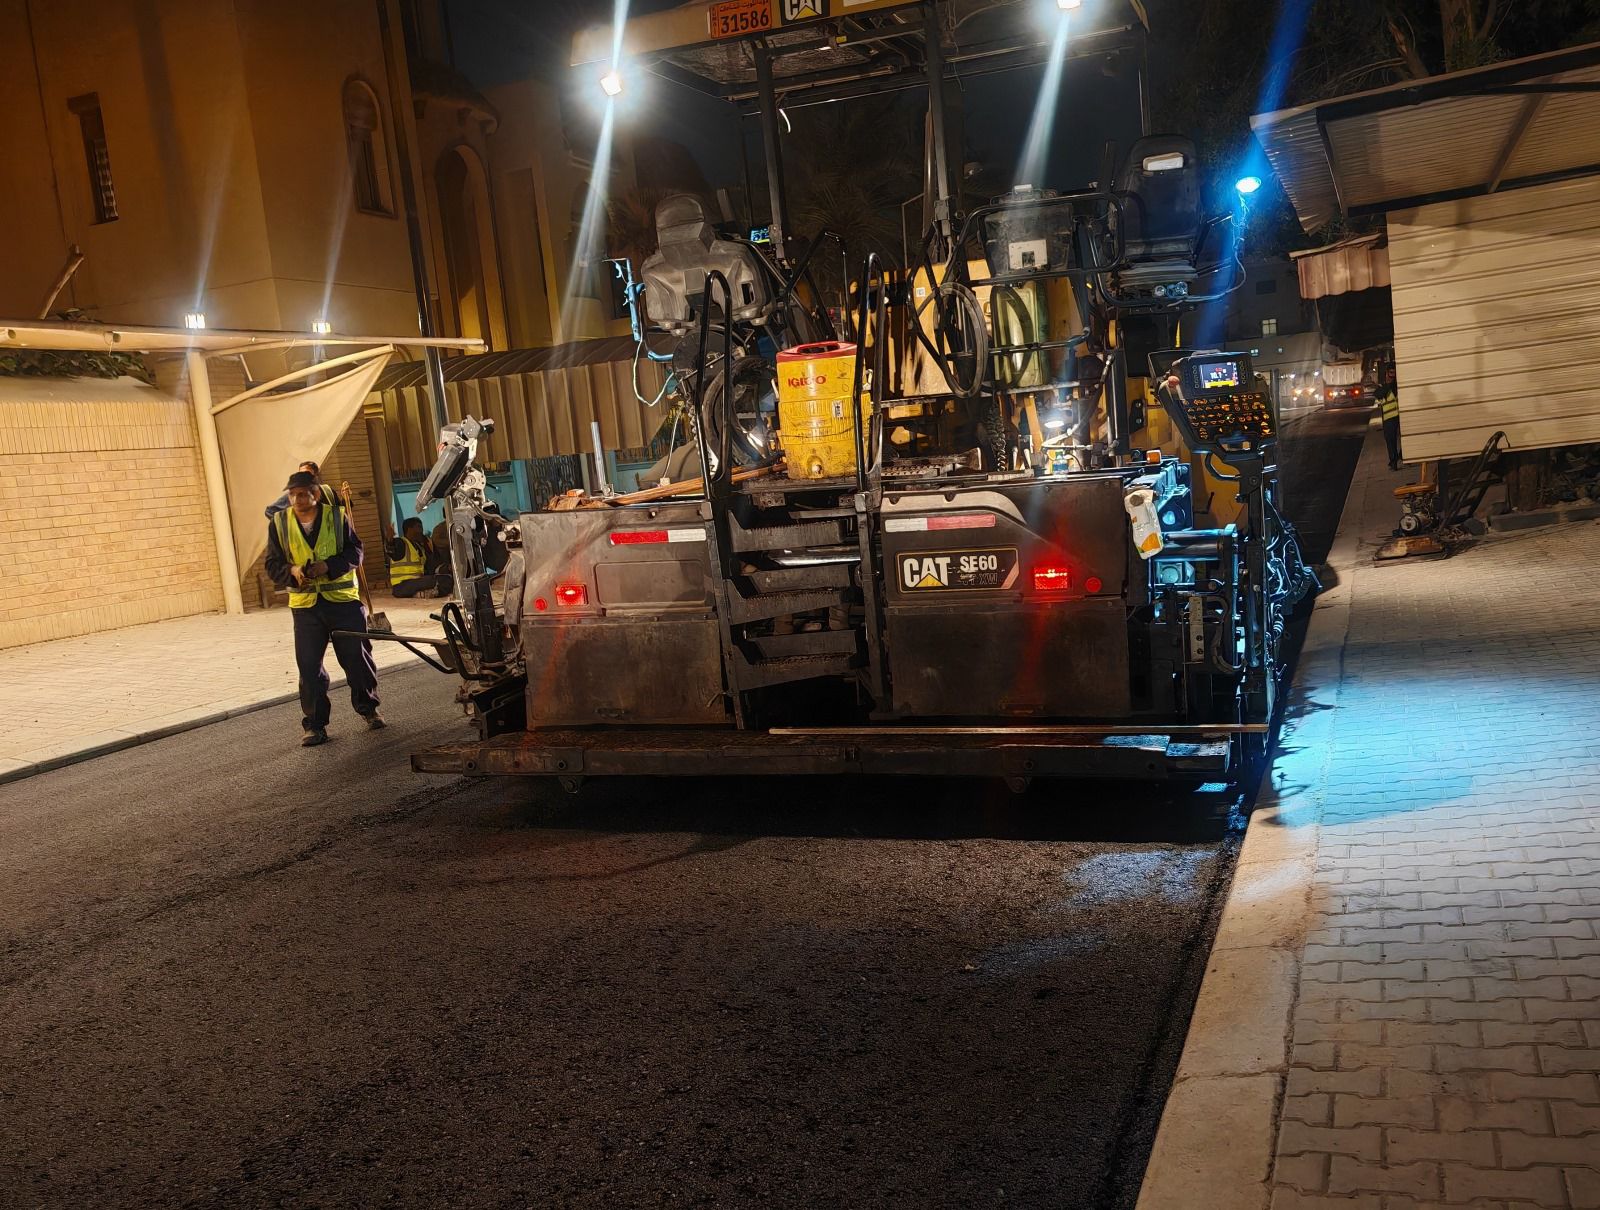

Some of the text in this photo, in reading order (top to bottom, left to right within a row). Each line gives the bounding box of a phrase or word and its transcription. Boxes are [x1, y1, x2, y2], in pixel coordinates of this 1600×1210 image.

[720, 8, 769, 34] 31586
[903, 557, 951, 587] CAT
[960, 555, 998, 572] SE60
